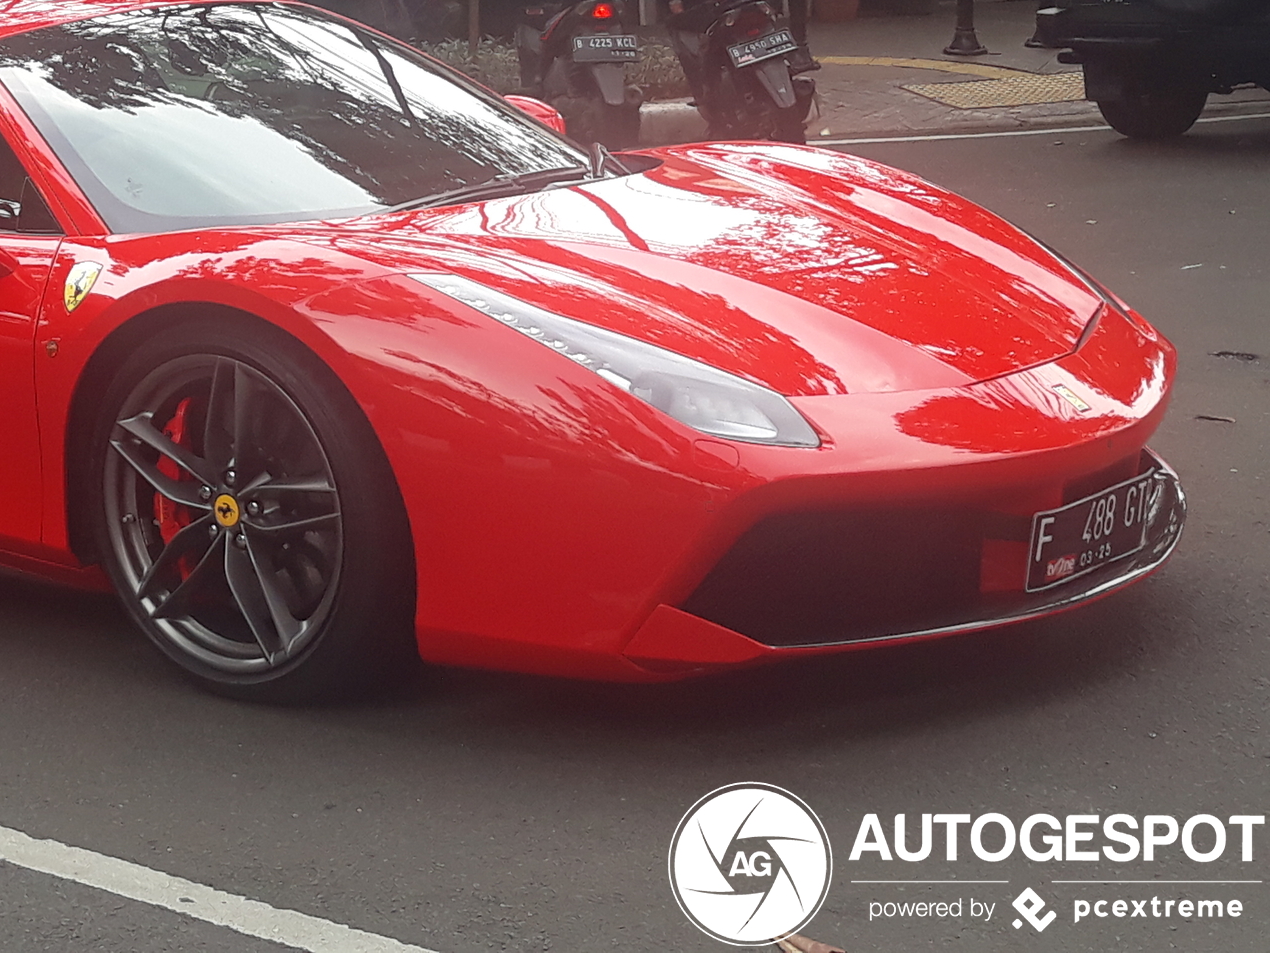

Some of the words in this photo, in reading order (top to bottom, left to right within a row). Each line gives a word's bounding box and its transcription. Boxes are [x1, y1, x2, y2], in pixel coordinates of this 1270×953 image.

[576, 39, 583, 49] B
[589, 38, 613, 48] 4225
[615, 37, 635, 48] KCL
[732, 48, 740, 58] B
[744, 40, 767, 53] 4950
[768, 32, 789, 46] SHA
[1035, 516, 1055, 562] F
[1082, 493, 1117, 544] 488
